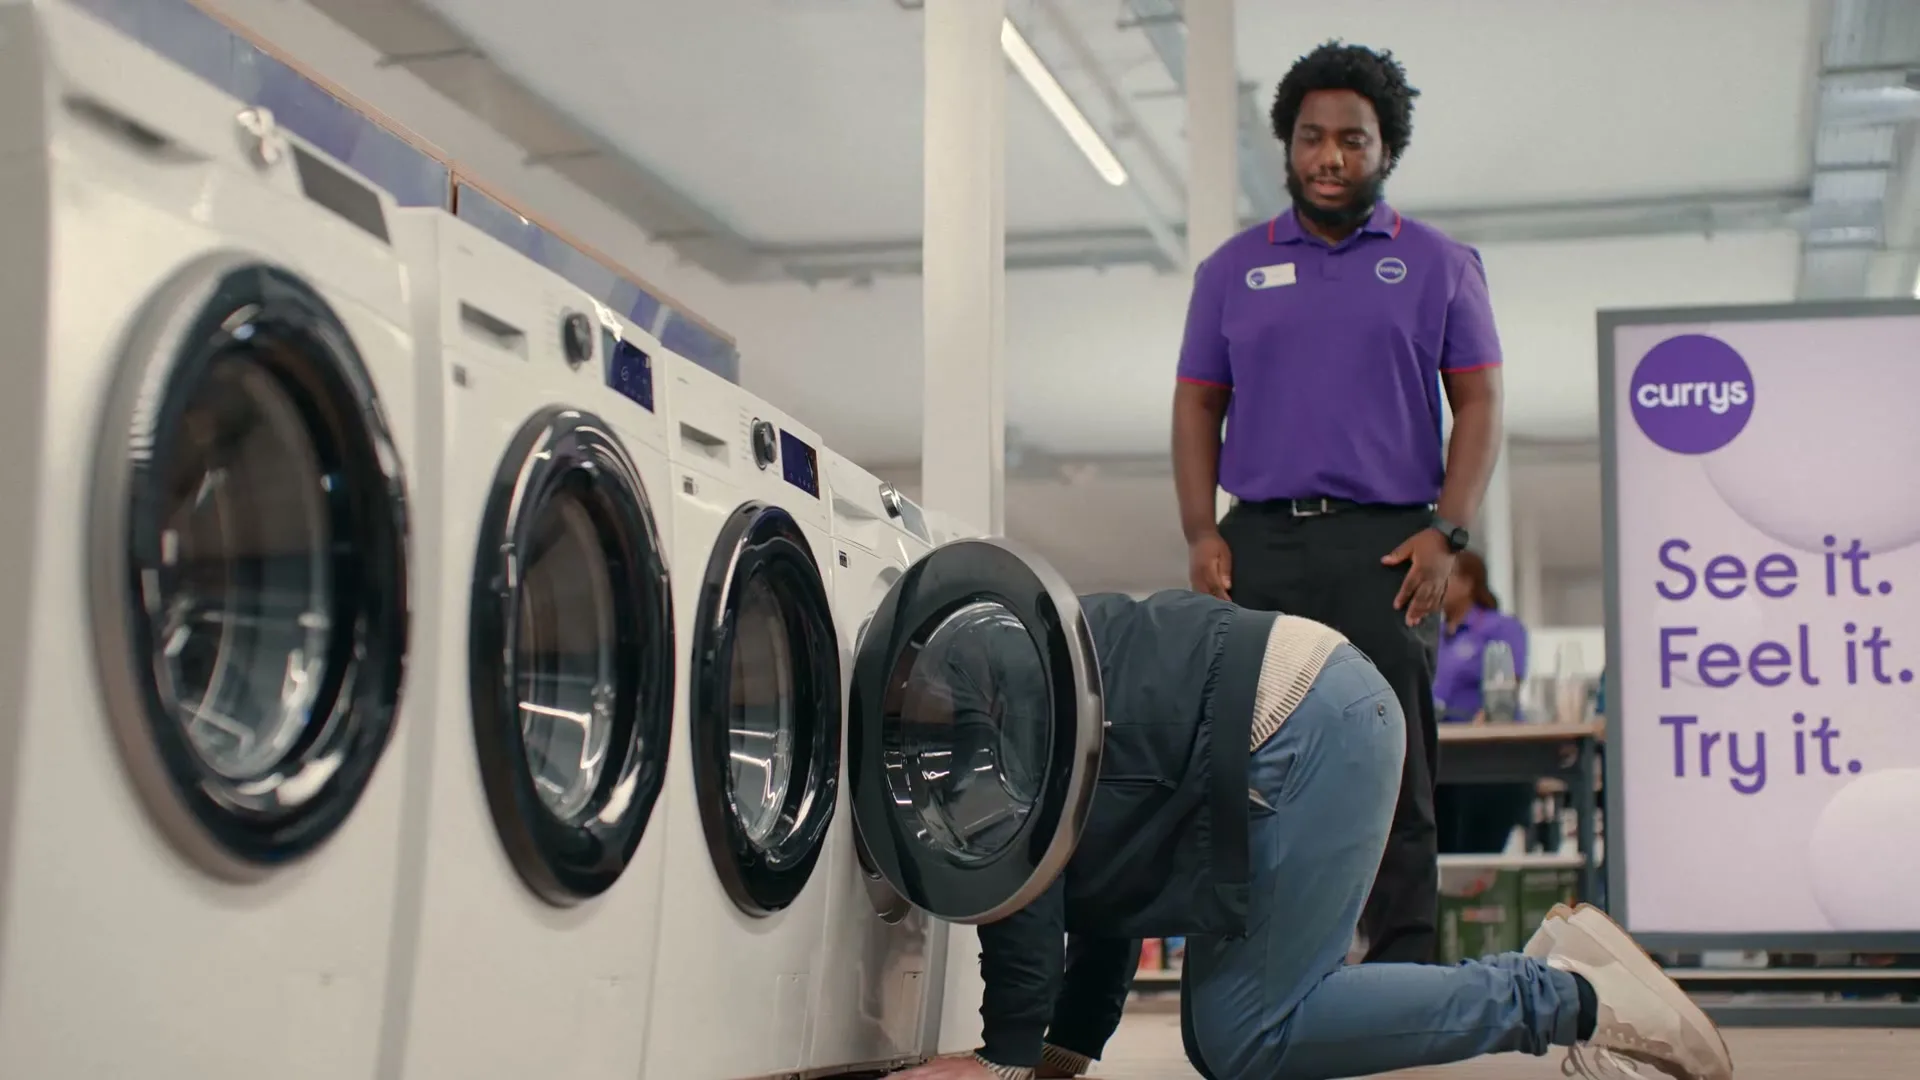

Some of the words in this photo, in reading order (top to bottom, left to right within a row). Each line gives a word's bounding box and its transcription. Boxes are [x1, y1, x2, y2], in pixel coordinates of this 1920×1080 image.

[1637, 380, 1748, 414] currys
[1656, 539, 1798, 600] See
[1824, 535, 1893, 596] it.
[1659, 624, 1820, 689] Feel
[1844, 622, 1914, 685] it.
[1659, 715, 1767, 795] Try
[1792, 711, 1863, 776] it.
